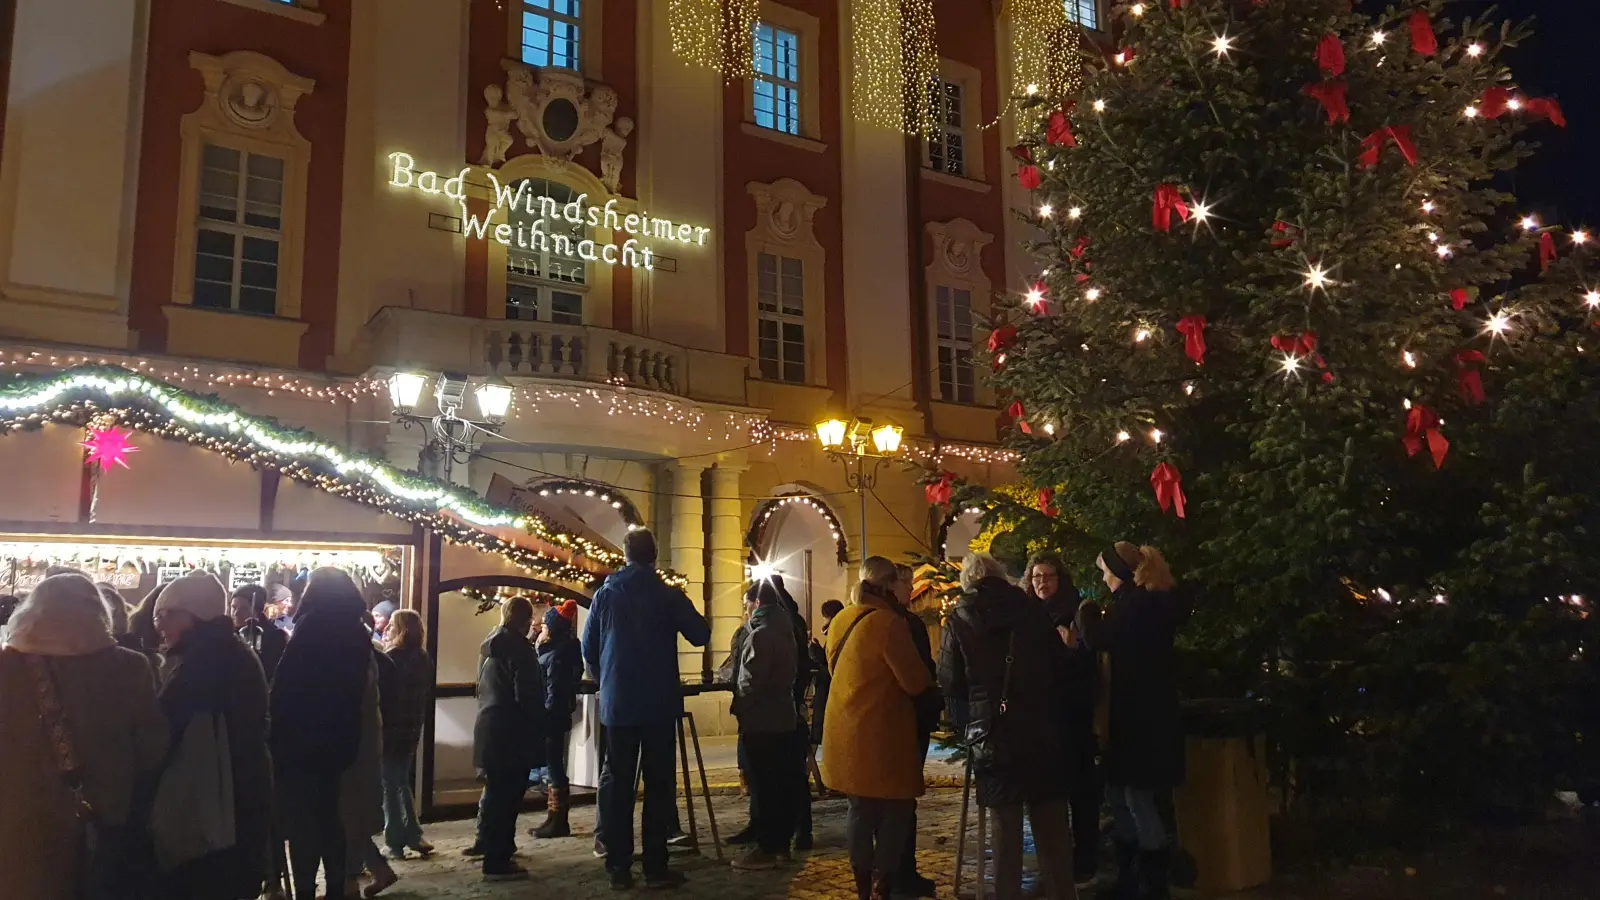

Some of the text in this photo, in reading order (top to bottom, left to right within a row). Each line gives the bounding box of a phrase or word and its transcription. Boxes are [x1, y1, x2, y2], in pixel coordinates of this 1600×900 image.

[387, 151, 710, 246] Bad Windsheimer
[459, 200, 653, 271] Weihnacht
